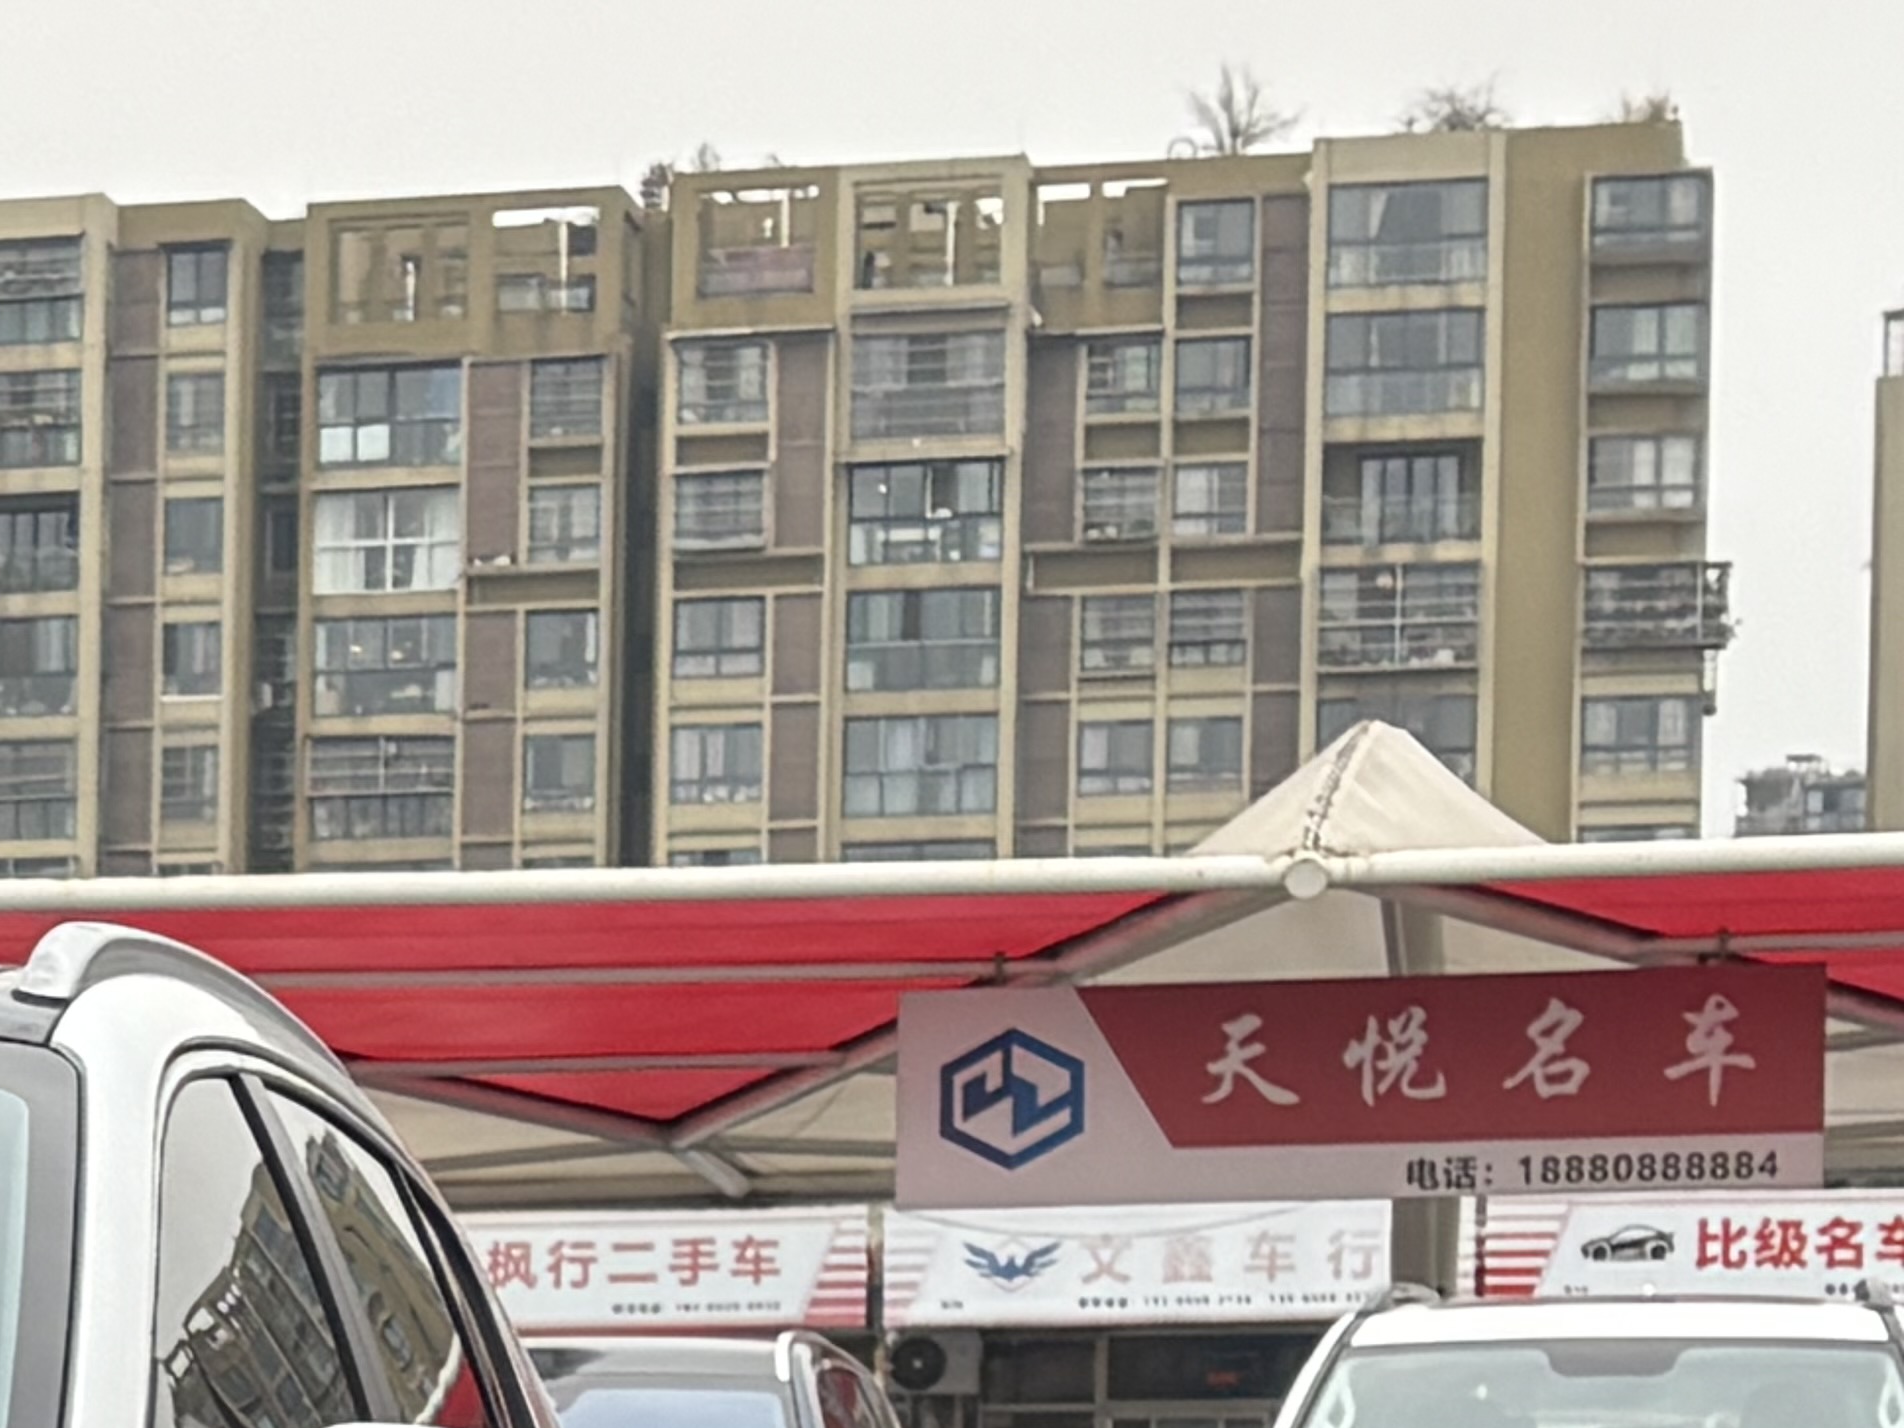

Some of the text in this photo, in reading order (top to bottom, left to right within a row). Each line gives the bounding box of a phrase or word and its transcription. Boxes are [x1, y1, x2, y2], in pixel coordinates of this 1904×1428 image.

[1202, 994, 1755, 1107] 天悦名车
[1519, 1151, 1778, 1185] 18880888884
[488, 1235, 781, 1290] 枫行二手车
[1081, 1231, 1380, 1283] 文鑫车行
